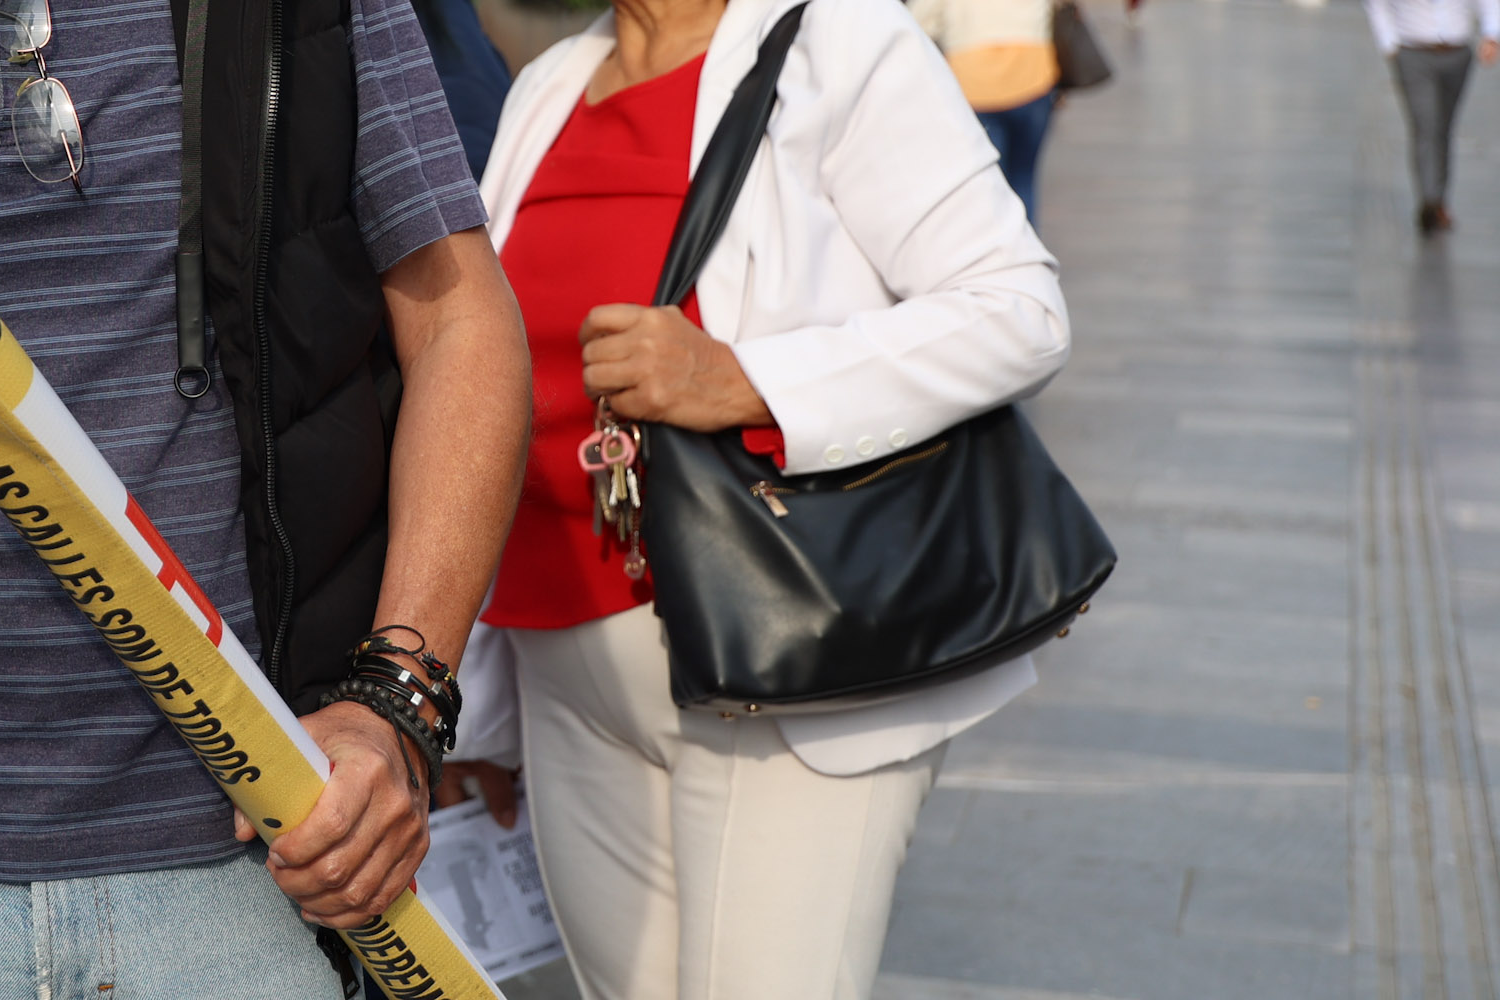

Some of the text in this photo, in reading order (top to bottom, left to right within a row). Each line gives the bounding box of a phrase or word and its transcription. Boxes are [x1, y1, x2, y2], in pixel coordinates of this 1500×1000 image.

[82, 608, 163, 663] SON
[130, 662, 195, 700] DE
[162, 699, 261, 785] TODOS
